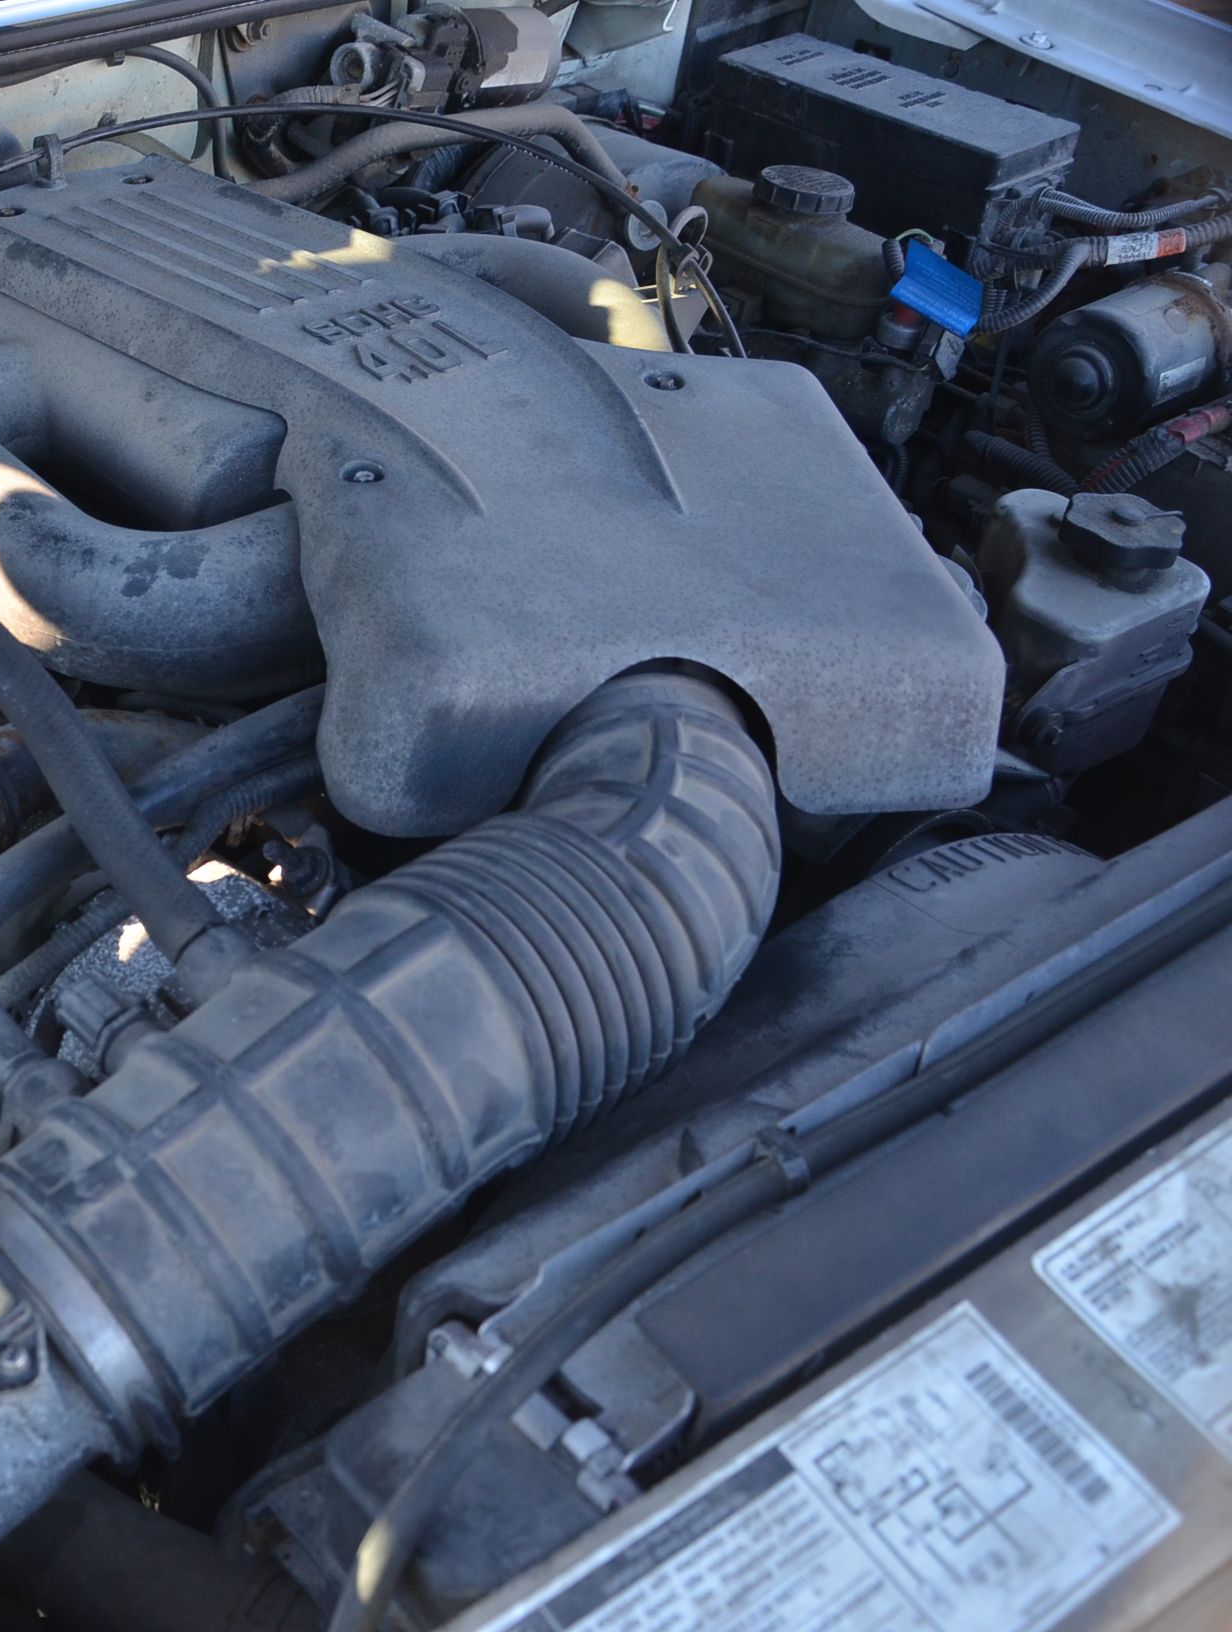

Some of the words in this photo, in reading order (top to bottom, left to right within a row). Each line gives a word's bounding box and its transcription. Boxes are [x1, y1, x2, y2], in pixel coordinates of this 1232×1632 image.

[301, 296, 441, 345] SOHC
[350, 319, 510, 384] 4.0L
[888, 833, 1061, 893] CAUTION
